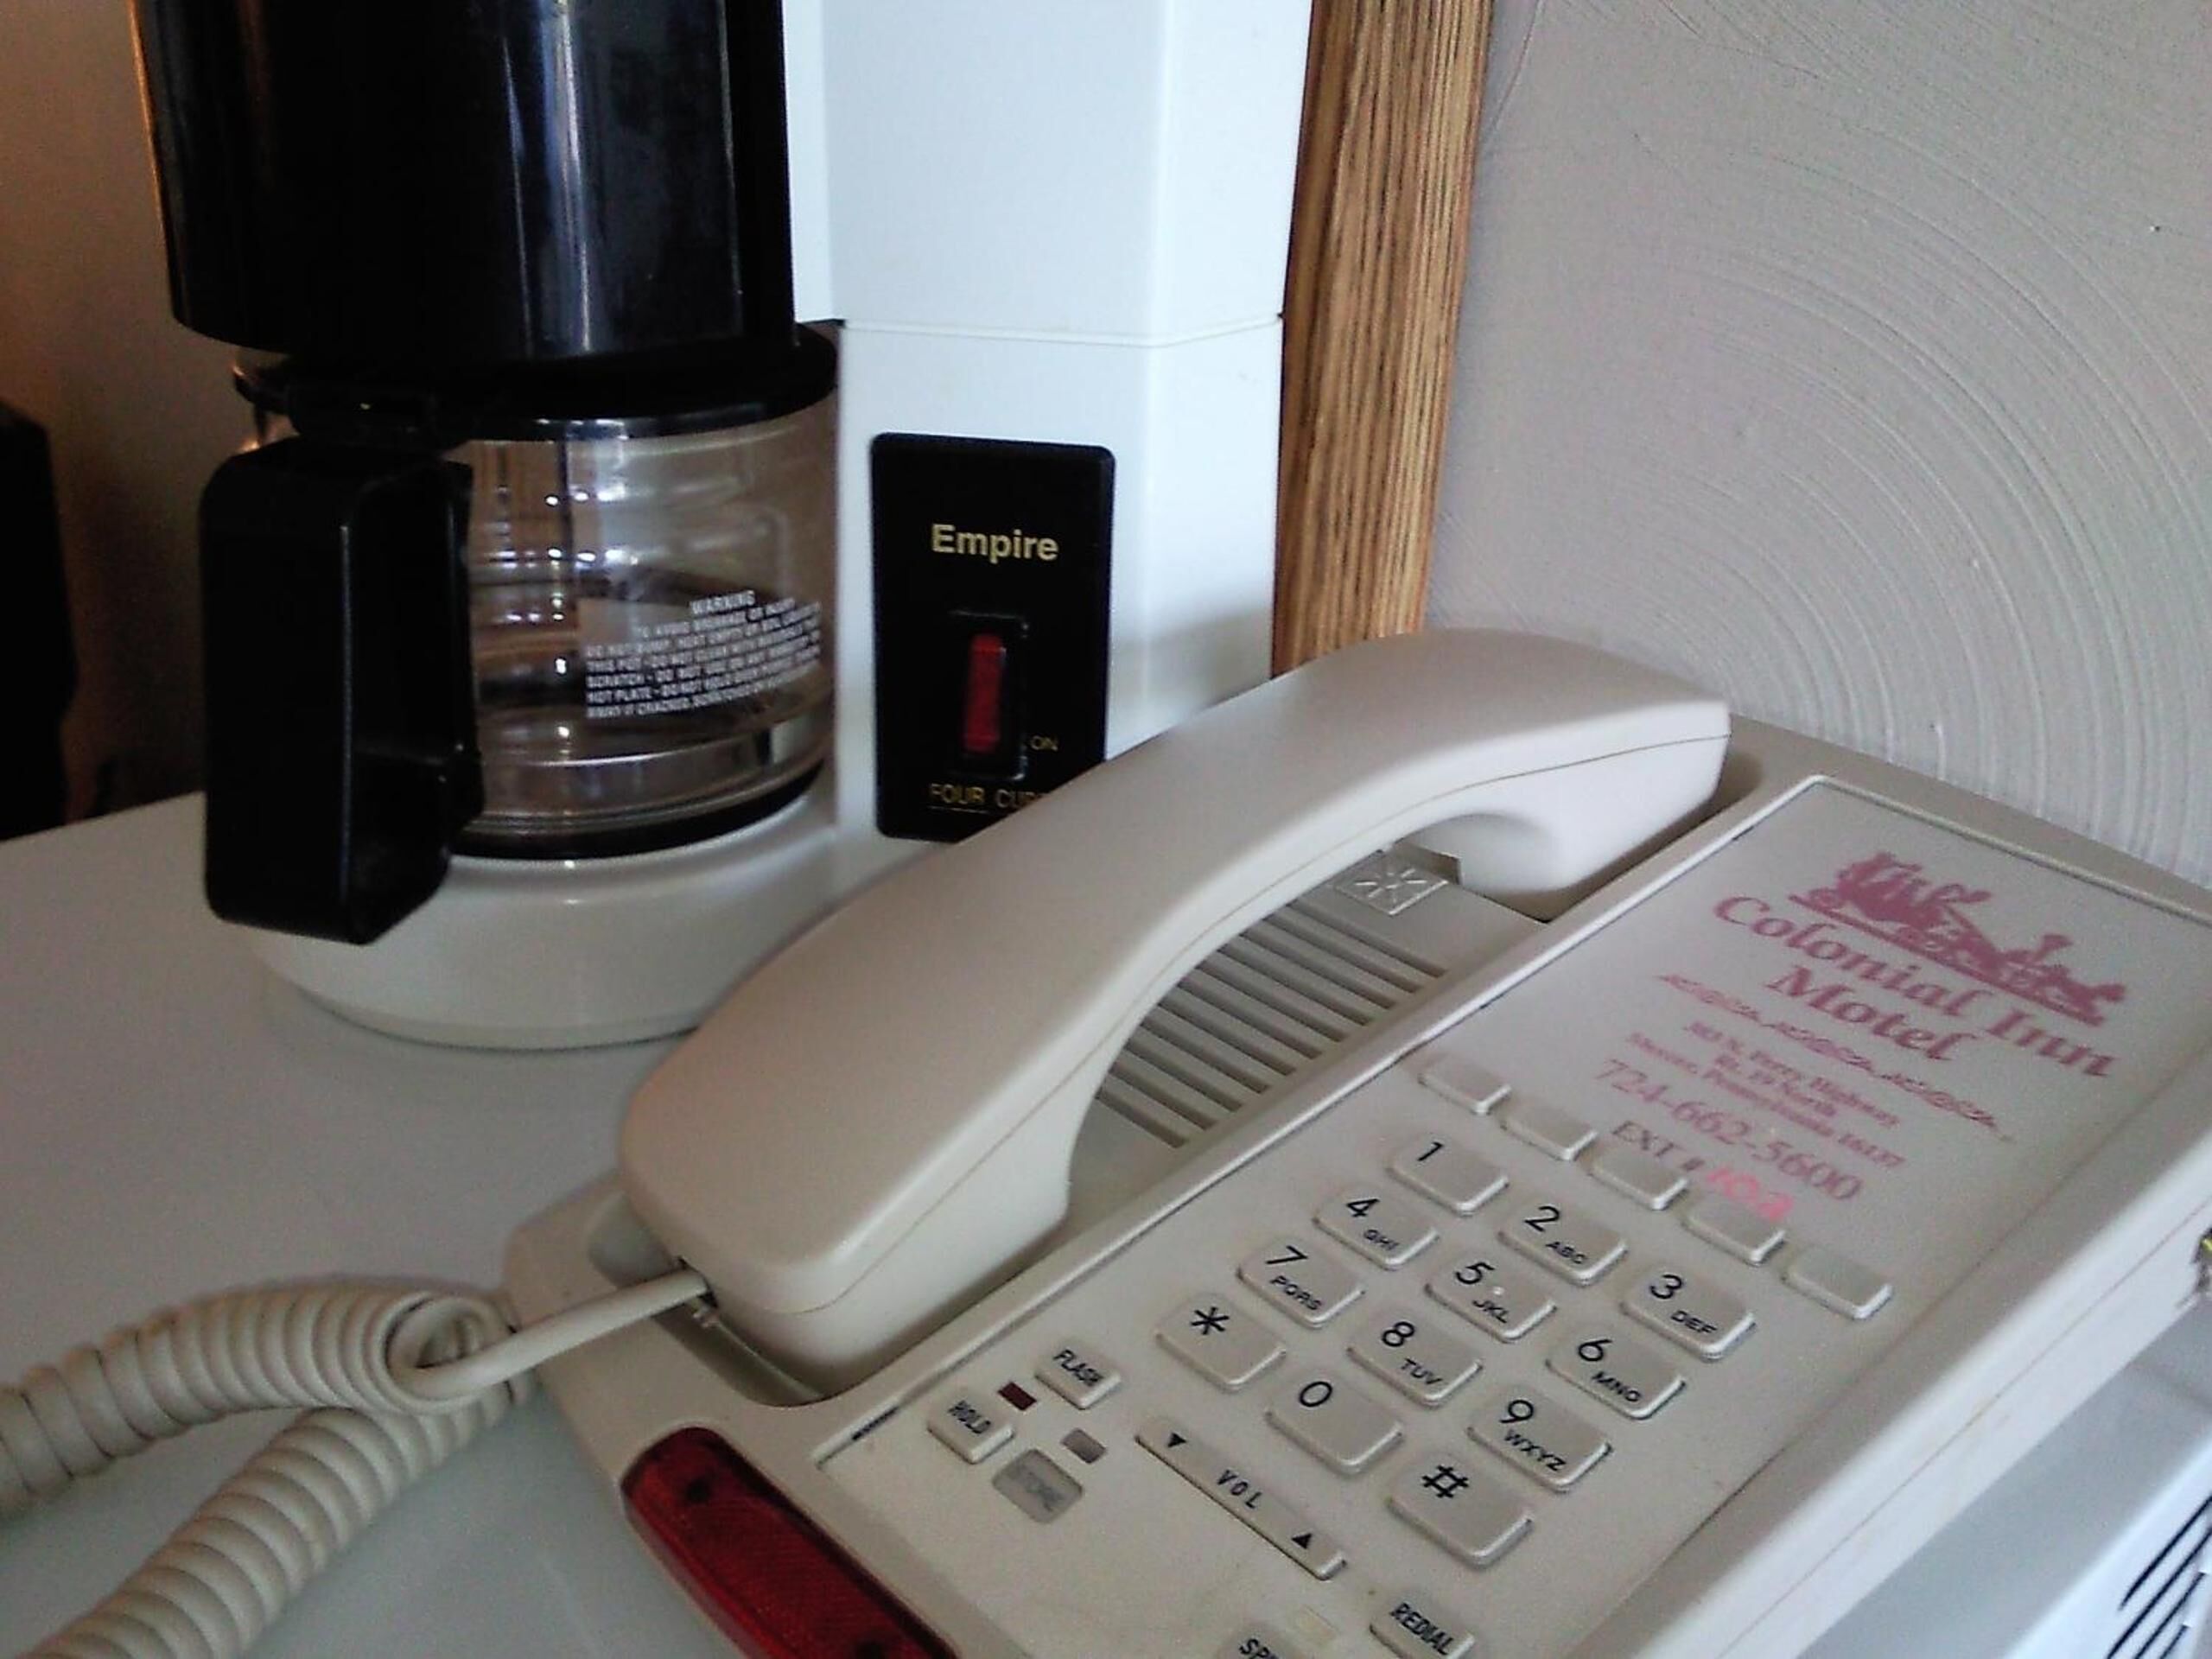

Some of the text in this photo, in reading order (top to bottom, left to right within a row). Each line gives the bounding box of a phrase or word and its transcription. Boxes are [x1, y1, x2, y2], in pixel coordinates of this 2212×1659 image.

[932, 523, 1059, 564] Empire
[1031, 736, 1058, 751] ON
[929, 783, 986, 804] FOUR
[1713, 896, 2119, 1077] Colonial Inn
[1764, 965, 1977, 1060] Motel
[1595, 1058, 1865, 1201] 724-662-5600
[1611, 1120, 1683, 1159] EXT
[1418, 1141, 1445, 1162] 1
[1346, 1198, 1380, 1218] 4
[1524, 1205, 1560, 1232] 2
[1265, 1245, 1308, 1265] 7
[1545, 1242, 1588, 1264] ABC
[1455, 1262, 1495, 1285] 5
[1649, 1274, 1684, 1300] 3
[1472, 1299, 1510, 1324] JKL
[1670, 1309, 1718, 1335] DEF
[1382, 1321, 1415, 1347] 8
[1577, 1338, 1613, 1362] 6
[1052, 1348, 1105, 1388] FLASH
[1400, 1357, 1444, 1385] TUV
[1299, 1381, 1333, 1408] 0
[1592, 1370, 1642, 1402] MNO
[948, 1400, 993, 1434] HOLD
[1498, 1399, 1535, 1424] 9
[1504, 1429, 1567, 1471] WXYZ
[1216, 1469, 1265, 1510] VOL
[1421, 1465, 1469, 1498] #
[1389, 1602, 1455, 1656] REDIAL
[1238, 1638, 1280, 1659] SP
